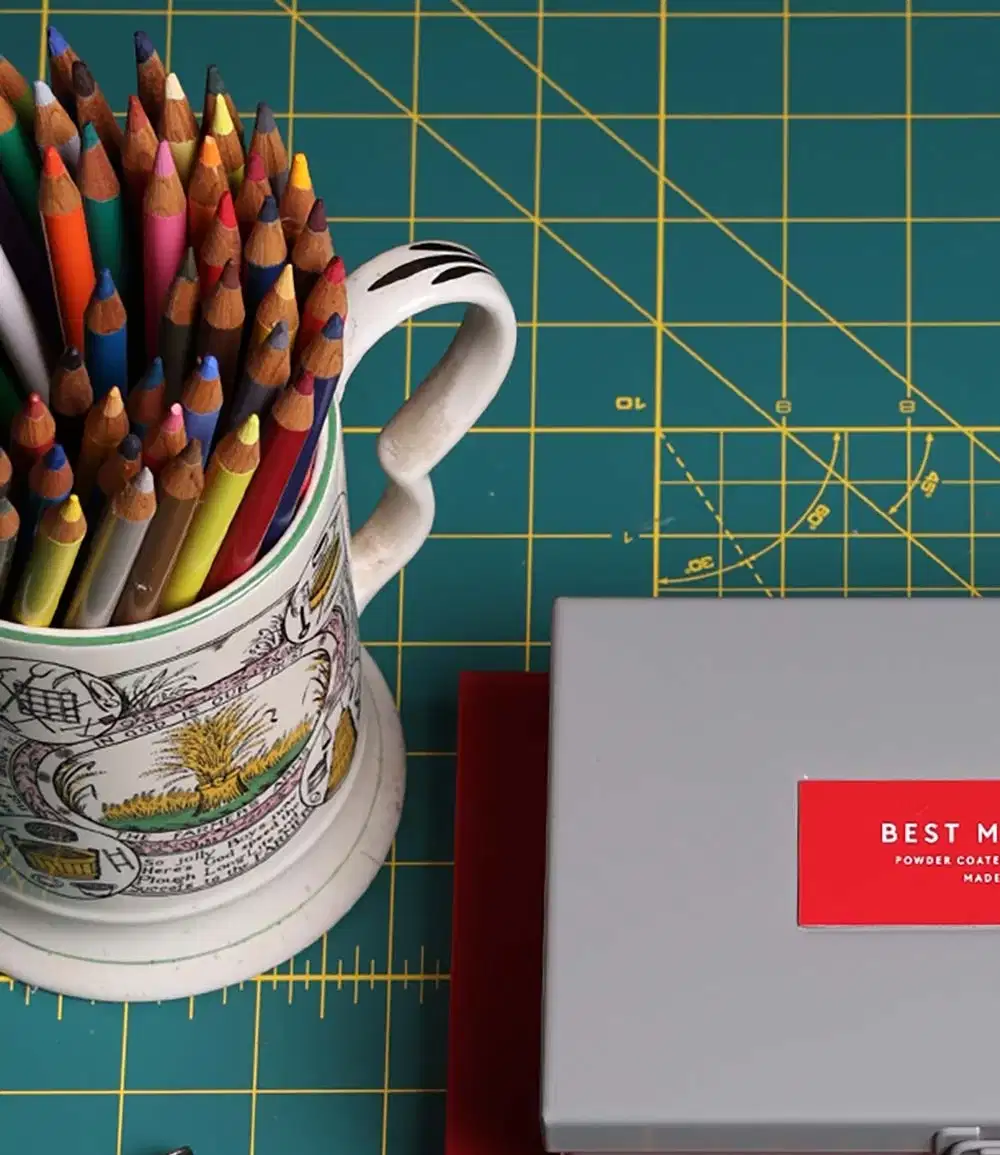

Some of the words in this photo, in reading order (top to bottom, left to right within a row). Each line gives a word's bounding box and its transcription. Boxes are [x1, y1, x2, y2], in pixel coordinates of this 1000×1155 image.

[614, 395, 646, 411] 10
[881, 822, 961, 844] BEST
[895, 855, 952, 866] POWDER
[963, 873, 1000, 883] MADE
